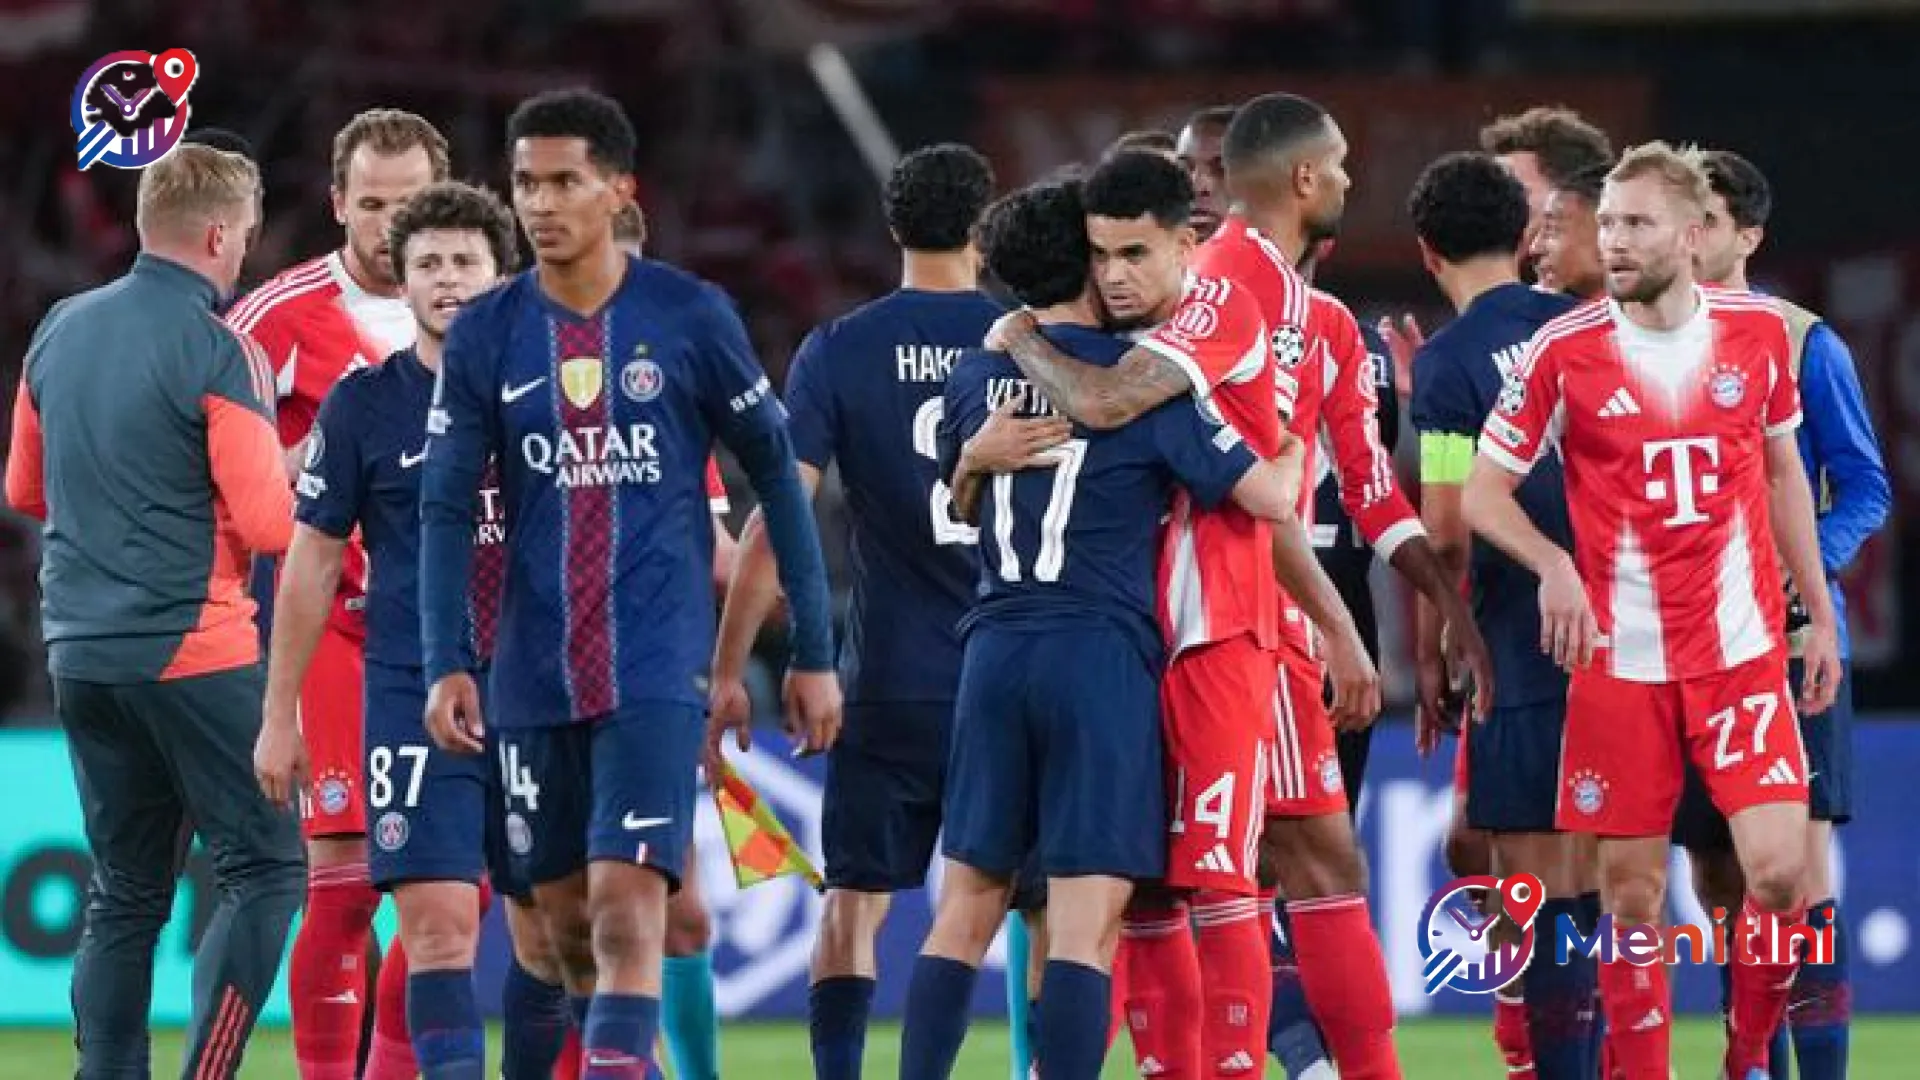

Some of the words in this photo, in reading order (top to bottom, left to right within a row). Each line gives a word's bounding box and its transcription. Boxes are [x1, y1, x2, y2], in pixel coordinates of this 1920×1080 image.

[522, 424, 660, 474] QATAR
[556, 461, 662, 488] AIRWAYS
[1642, 436, 1718, 528] T
[993, 439, 1089, 582] 17
[1706, 692, 1778, 770] 27
[370, 746, 429, 807] 87
[1170, 766, 1236, 838] 14
